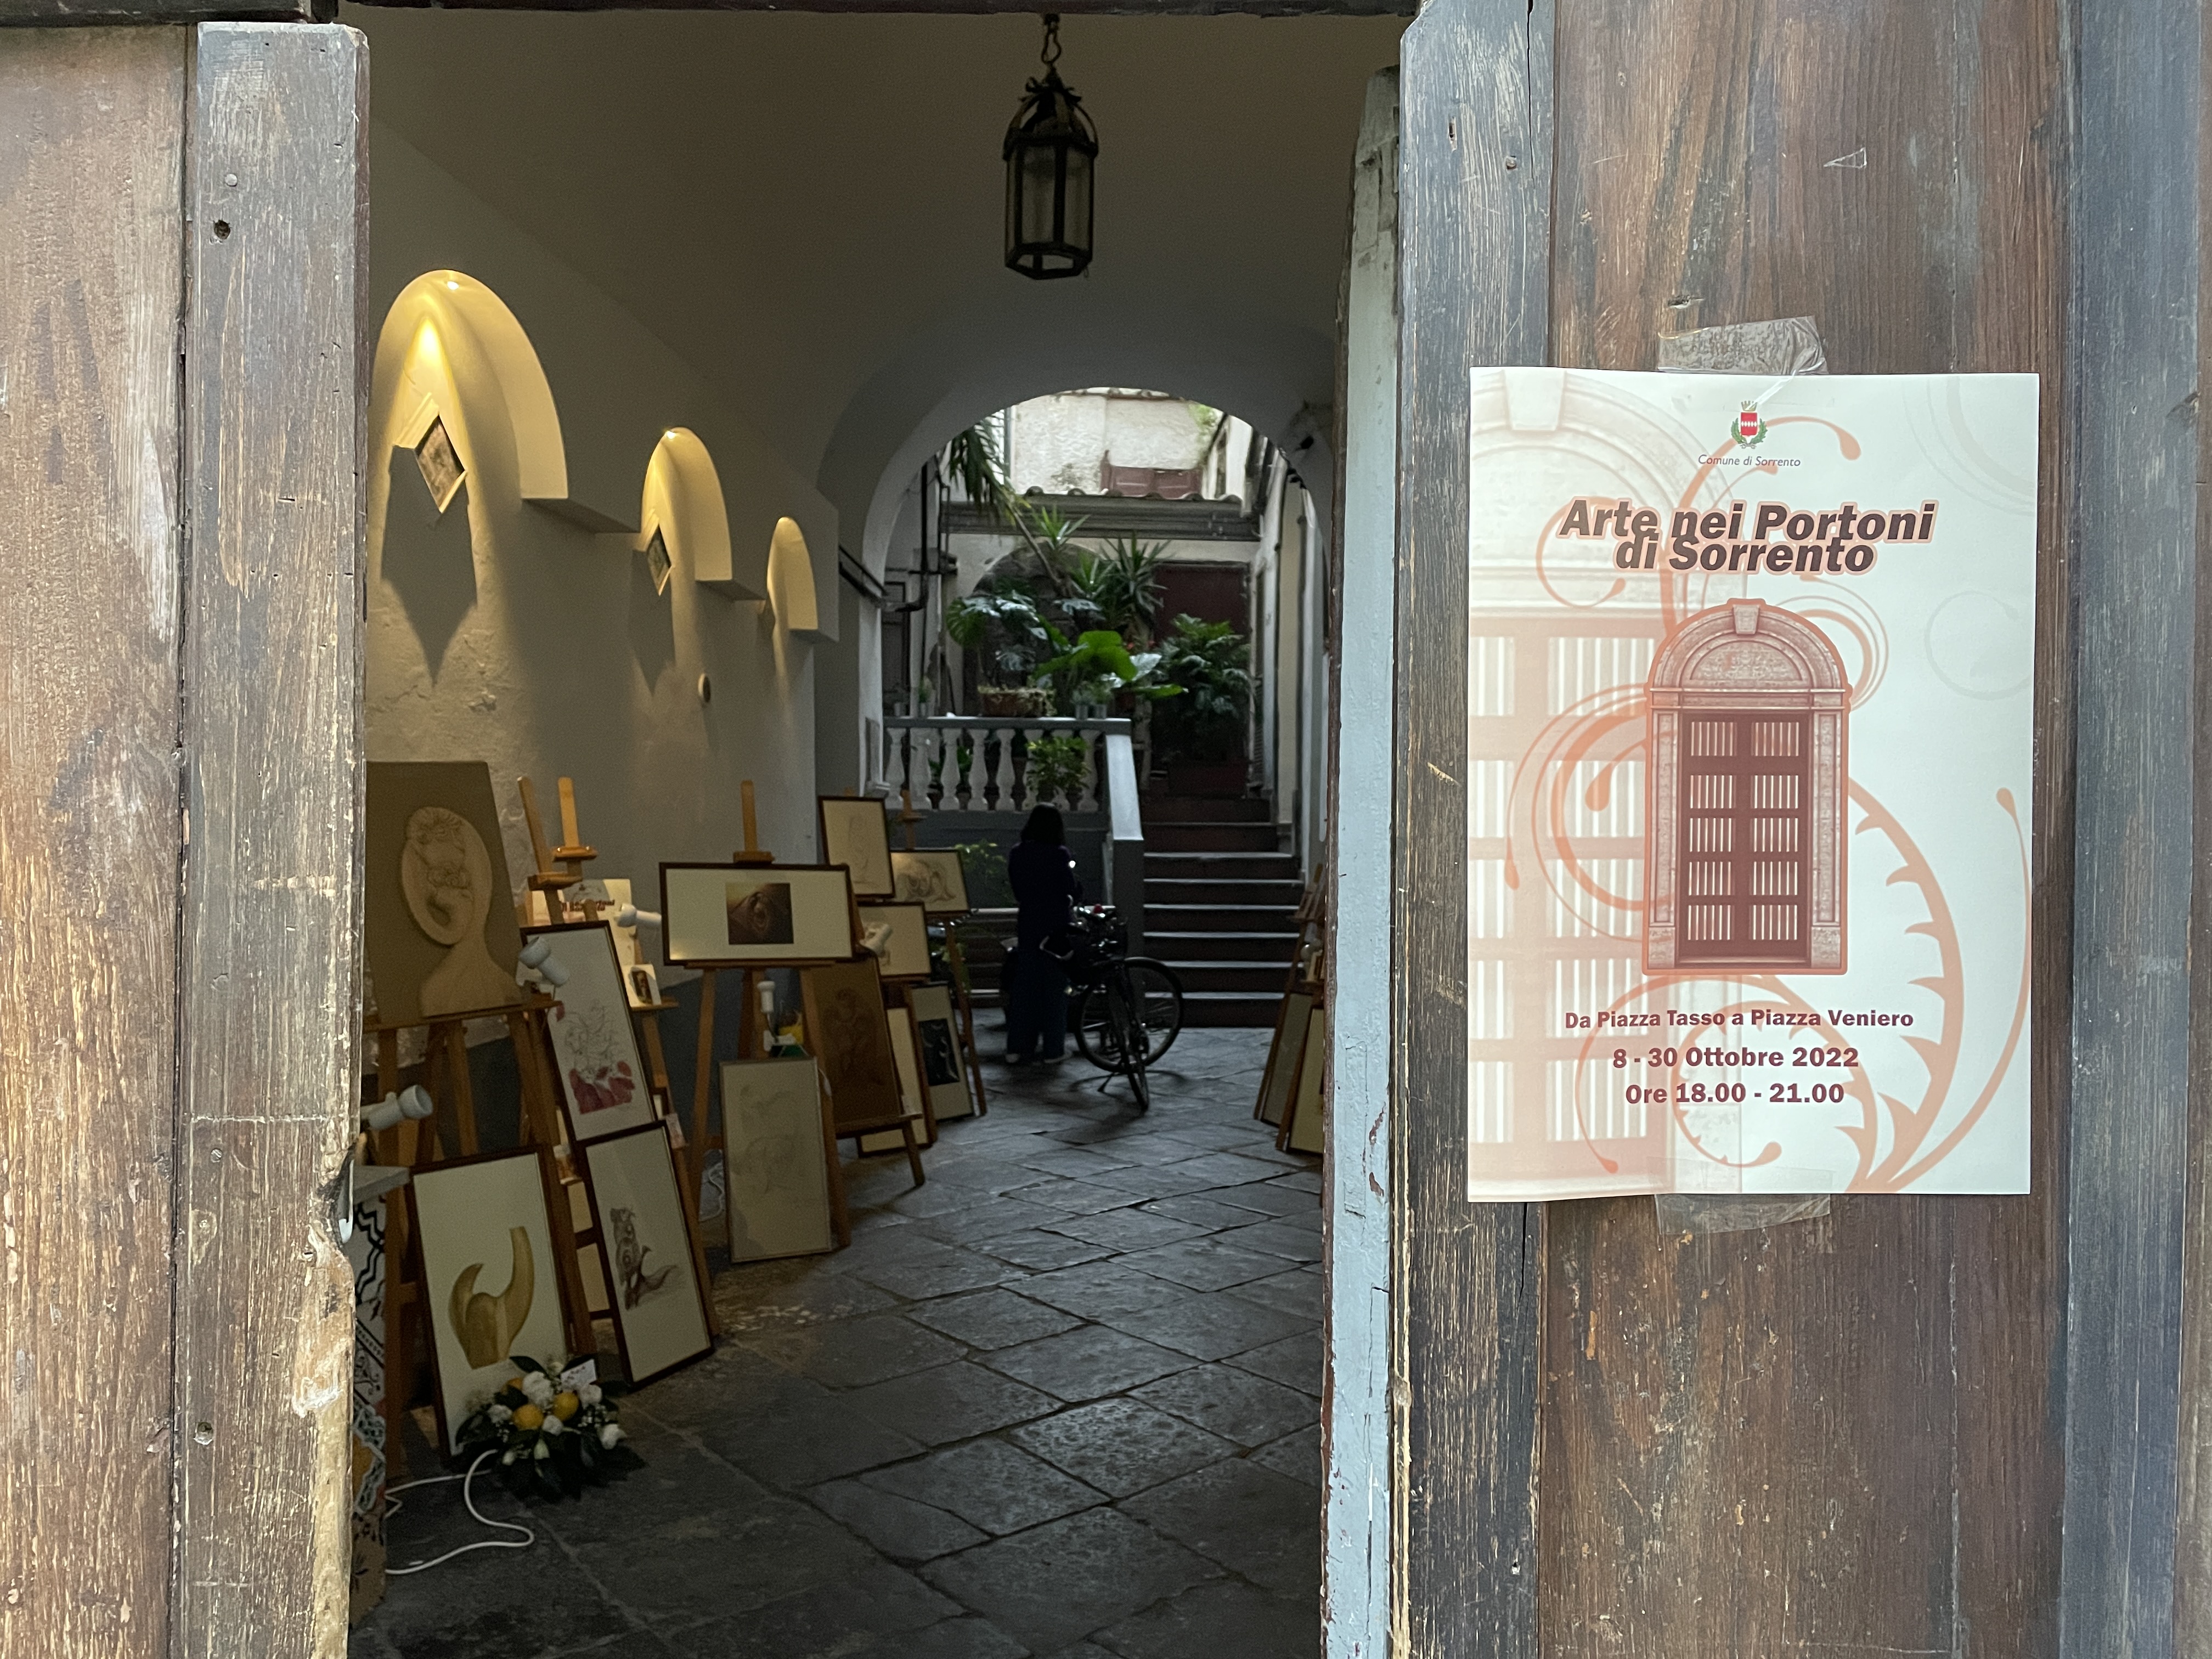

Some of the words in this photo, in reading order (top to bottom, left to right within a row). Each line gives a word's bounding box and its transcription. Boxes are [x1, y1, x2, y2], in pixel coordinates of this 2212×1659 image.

[1698, 454, 1740, 465] Comune
[1743, 456, 1753, 466] di
[1755, 456, 1801, 466] Sorrento
[1559, 500, 1658, 537] Arte
[1672, 503, 1743, 540] nei
[1755, 504, 1936, 540] Portoni
[1616, 528, 1659, 569] di
[1669, 535, 1874, 572] Sorrento
[1565, 1012, 1591, 1028] Da
[1598, 1011, 1661, 1028] Piazza
[1667, 1010, 1725, 1026] Tasso
[1731, 1013, 1744, 1025] a
[1751, 1009, 1821, 1026] Piazza
[1827, 1009, 1914, 1027] Veniero
[1613, 1048, 1627, 1069] 8
[1647, 1047, 1678, 1068] 30
[1685, 1047, 1784, 1066] Ottobre
[1792, 1047, 1859, 1067] 2022
[1626, 1084, 1668, 1104] Ore
[1676, 1082, 1746, 1103] 18.00
[1769, 1083, 1844, 1103] 21.00
